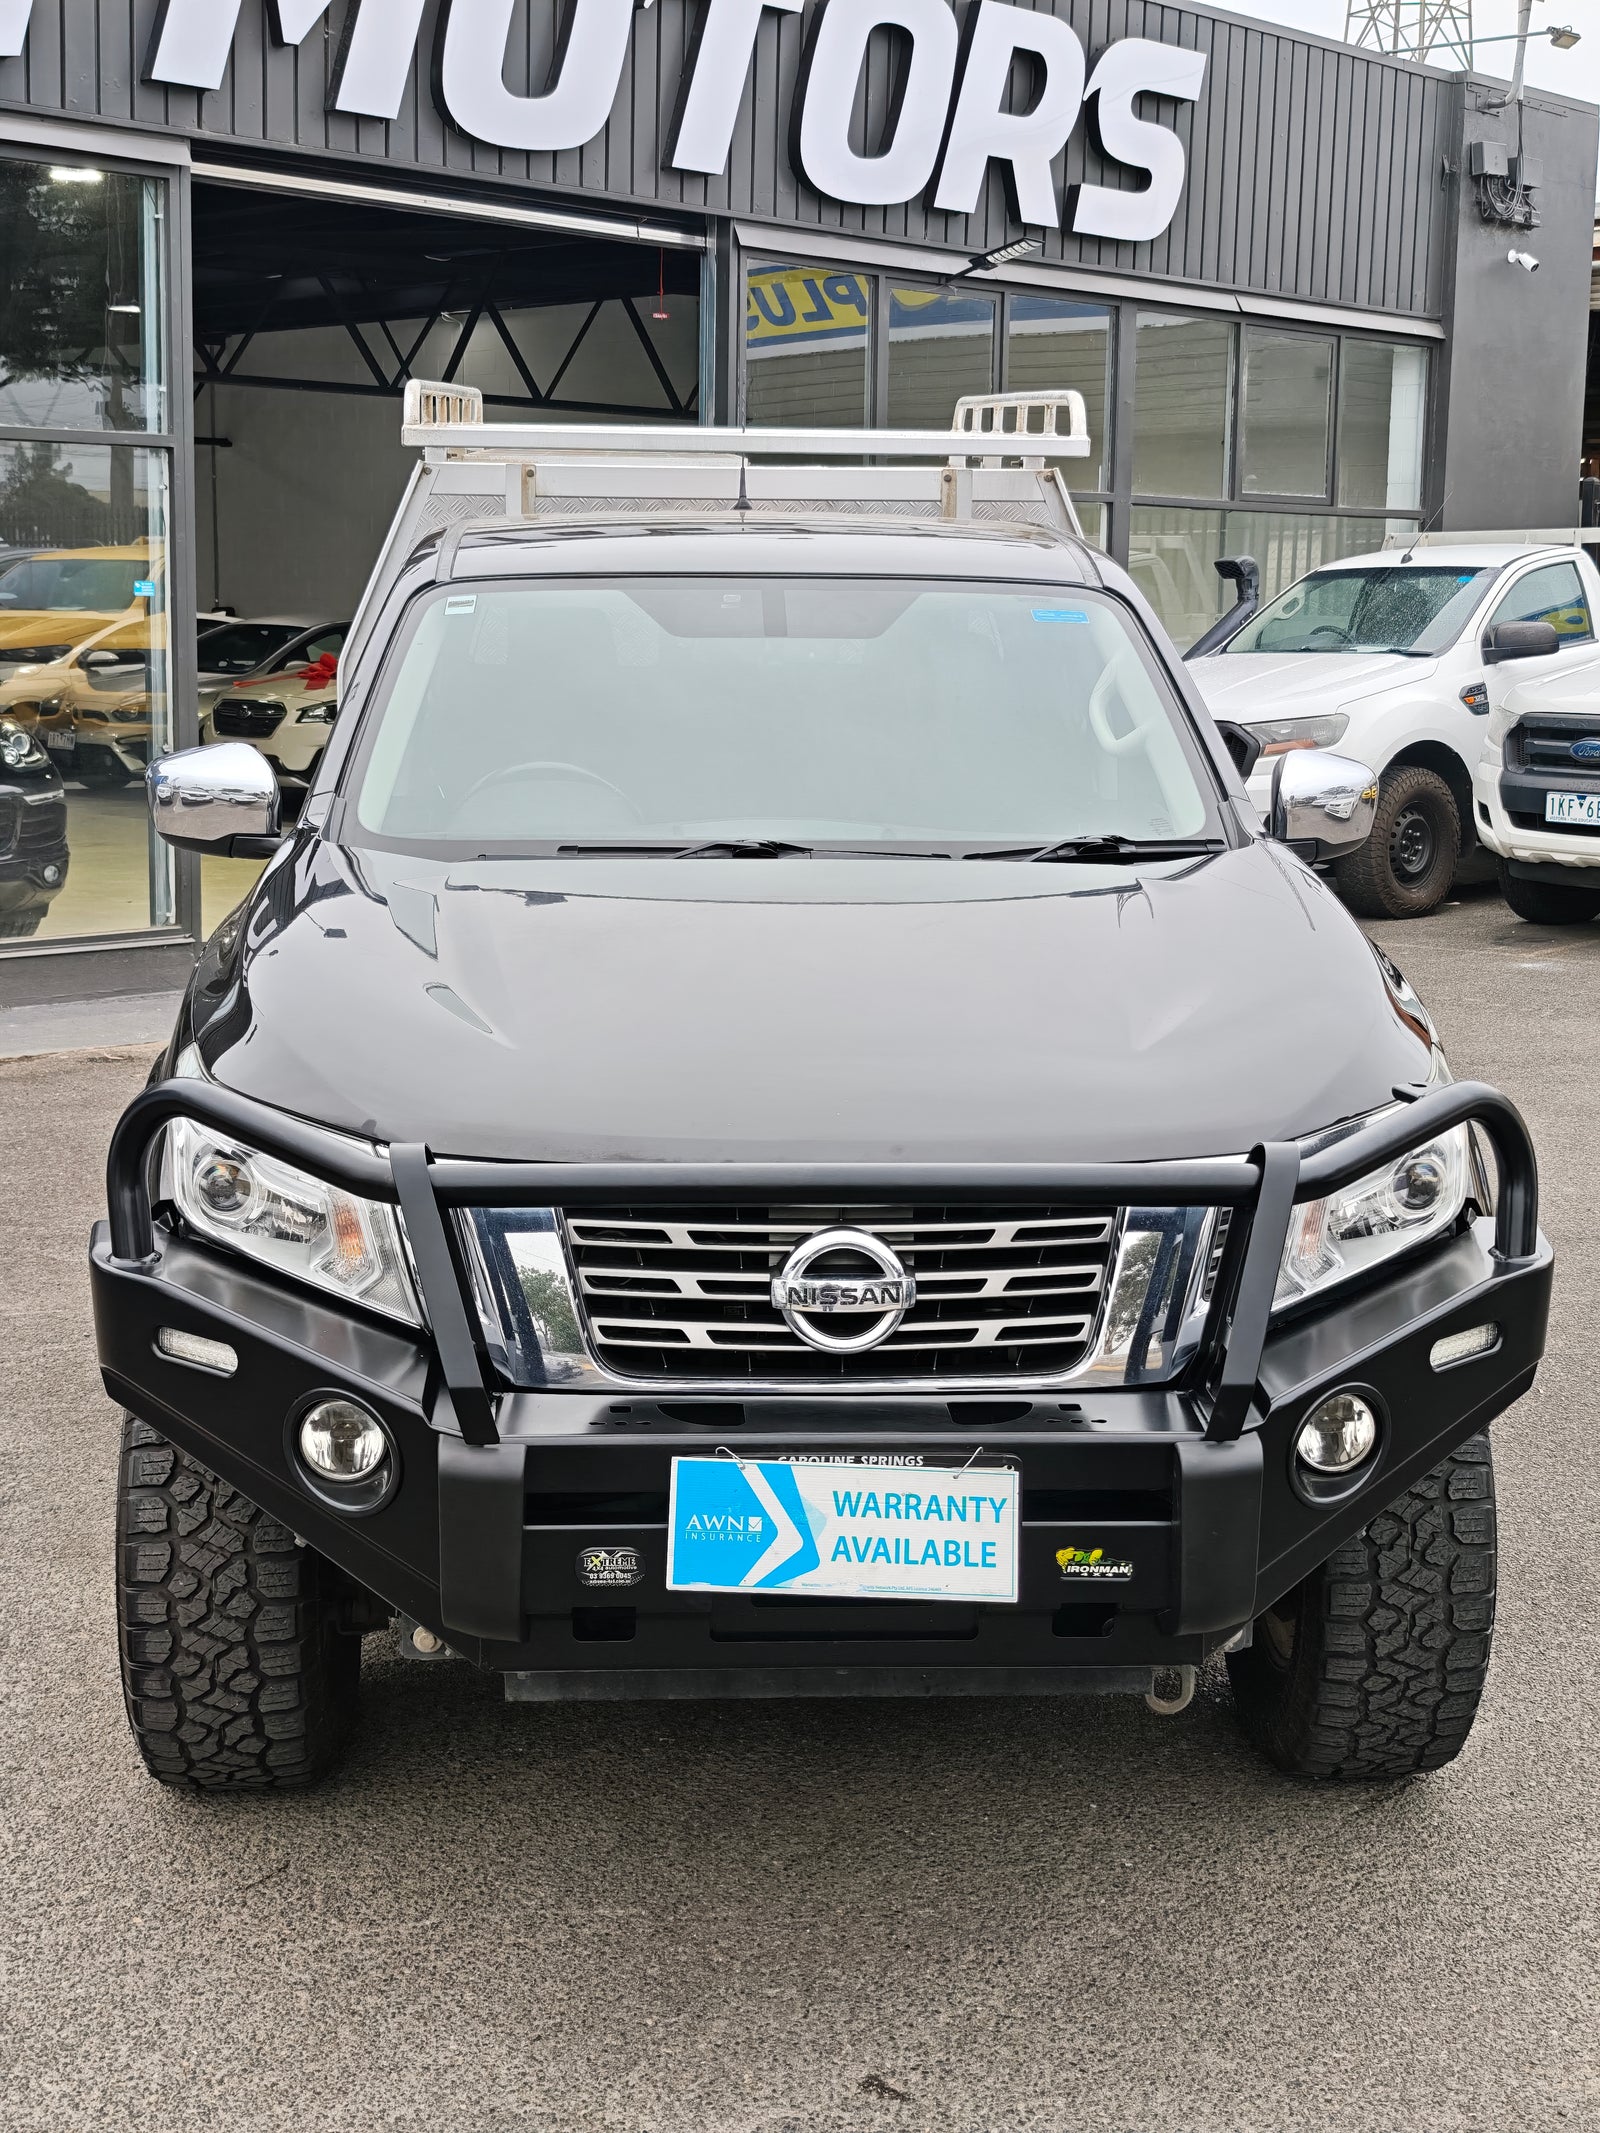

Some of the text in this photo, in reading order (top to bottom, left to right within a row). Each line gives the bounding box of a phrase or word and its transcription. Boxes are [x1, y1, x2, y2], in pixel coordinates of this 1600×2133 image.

[146, 0, 1206, 241] MOTORS
[1551, 797, 1575, 817] 1KF
[787, 1286, 901, 1306] NISSAN
[860, 1455, 924, 1467] SPRINGS
[832, 1491, 1008, 1524] WARRANTY
[685, 1514, 744, 1532] AWN
[685, 1532, 762, 1543] INSURANCE
[830, 1535, 998, 1569] AVAILABLE
[584, 1555, 636, 1570] EXTREME
[1067, 1565, 1129, 1573] IRONMAN
